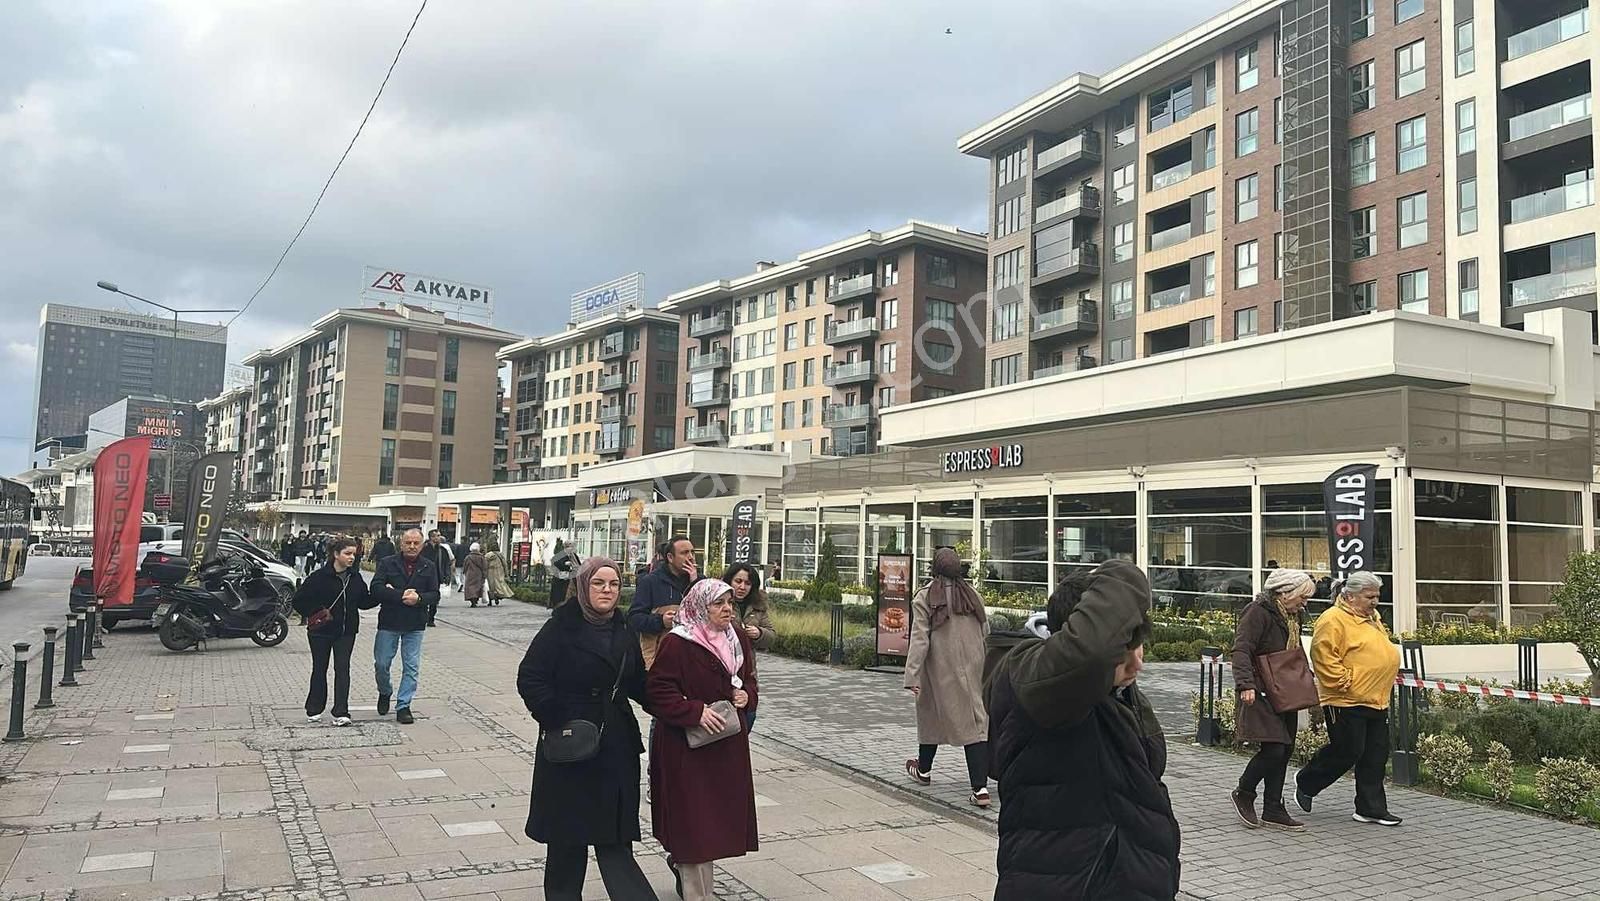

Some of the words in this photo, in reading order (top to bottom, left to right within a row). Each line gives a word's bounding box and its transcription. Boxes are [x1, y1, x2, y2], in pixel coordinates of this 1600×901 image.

[414, 280, 488, 303] AKYAPI
[944, 443, 1022, 472] ESPRESSOLAB
[114, 453, 131, 500] NEO
[200, 465, 217, 508] NEO
